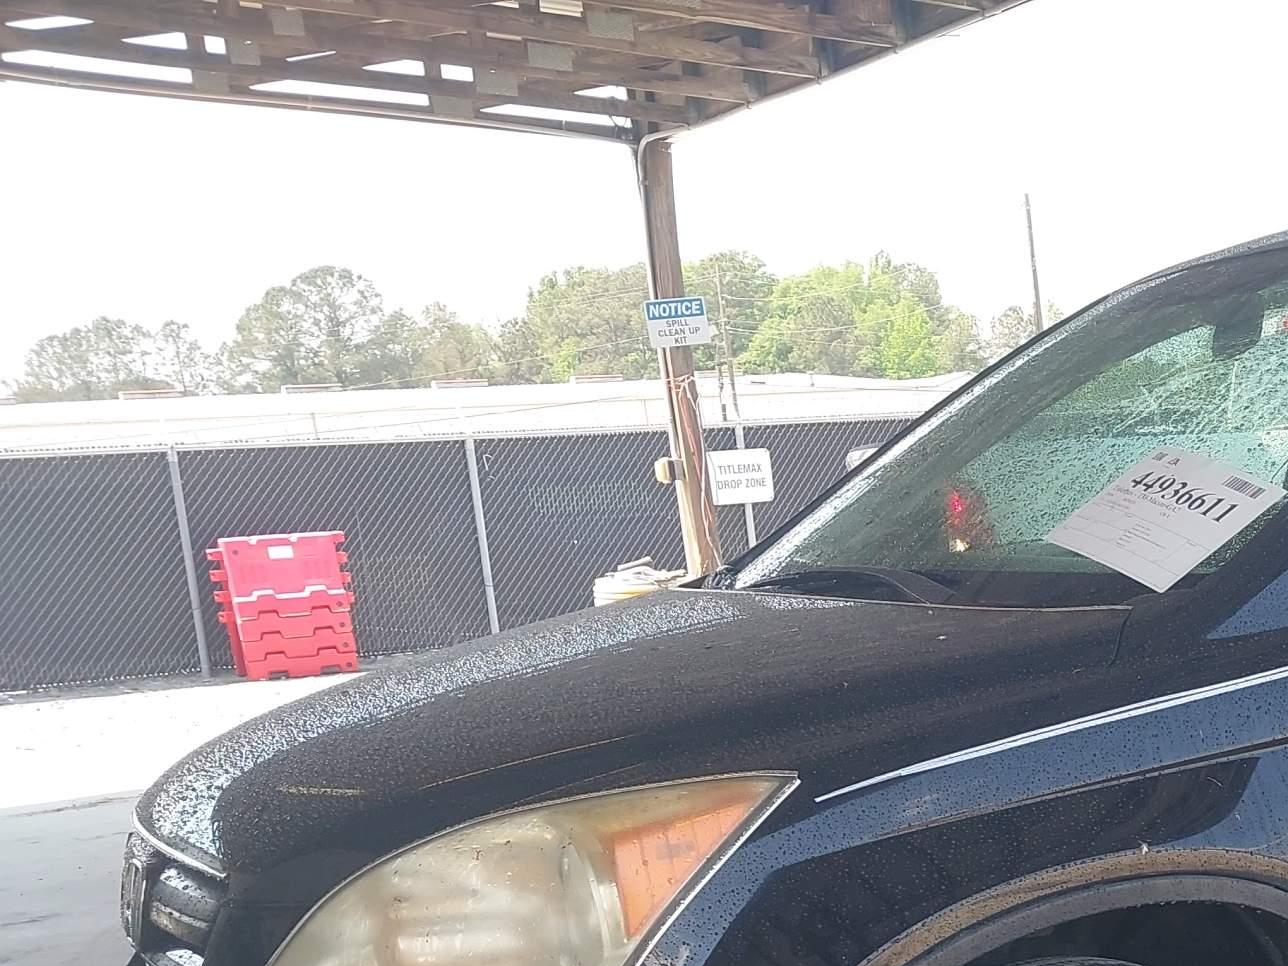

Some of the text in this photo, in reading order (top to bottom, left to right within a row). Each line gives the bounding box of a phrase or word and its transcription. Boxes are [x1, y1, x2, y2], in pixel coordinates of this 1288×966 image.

[649, 300, 702, 318] NOTICE
[665, 318, 690, 328] SPILL
[657, 326, 701, 338] CLEAN UP
[674, 335, 688, 345] KIT
[718, 463, 763, 475] TITLEMAX
[716, 477, 768, 490] DROP ZONE
[1130, 471, 1239, 523] 44936611
